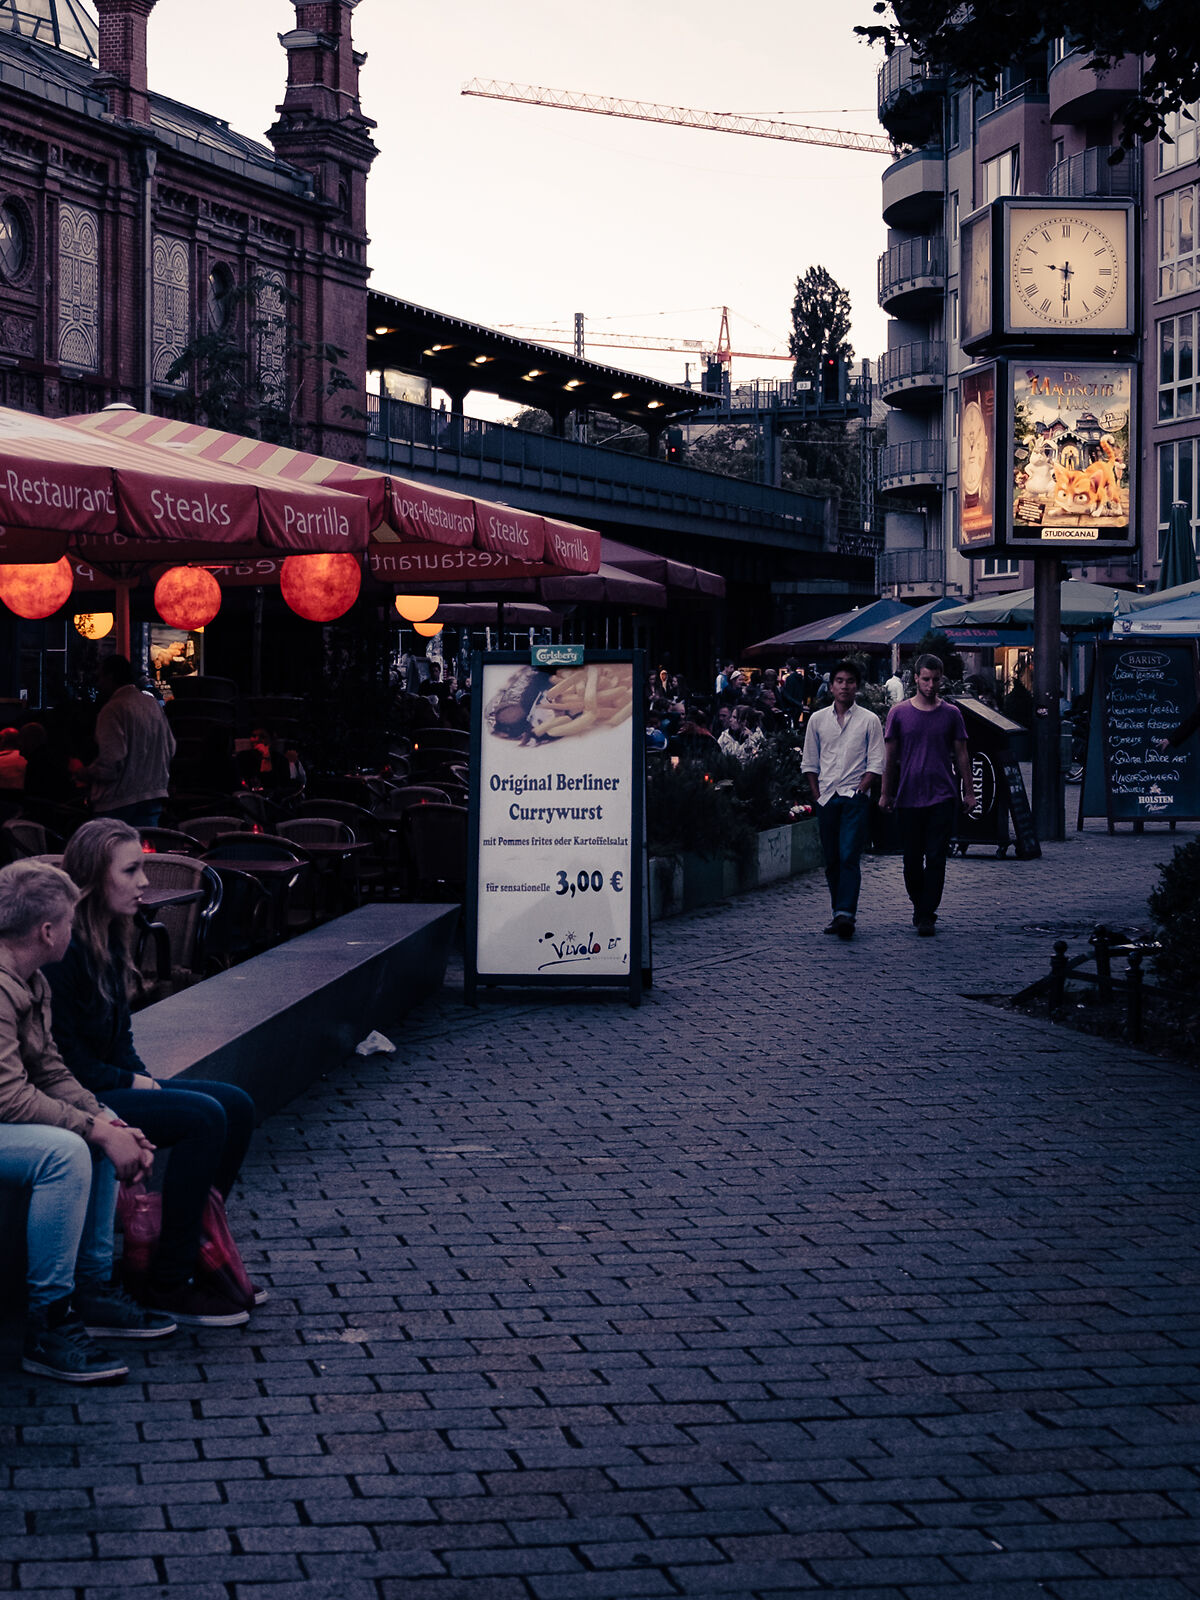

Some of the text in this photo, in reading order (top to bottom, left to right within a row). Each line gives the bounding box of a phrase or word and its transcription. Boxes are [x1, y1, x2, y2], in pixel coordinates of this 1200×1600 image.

[150, 489, 232, 527] Steaks
[391, 491, 475, 533] Tpas-Restaurant
[284, 504, 350, 538] Parrilla
[489, 515, 530, 546] Steaks
[1044, 530, 1096, 538] STUDIOCANAL
[554, 533, 589, 562] Parrilla
[536, 648, 578, 665] Carlsberg
[1128, 656, 1163, 665] BARIST
[490, 773, 620, 795] Original Berliner
[972, 757, 983, 815] BARIST
[1138, 796, 1174, 804] HOLSTEN
[509, 803, 603, 824] Currywurst
[483, 836, 628, 846] mit Pommes frites oder Kartoffelsalat
[486, 870, 624, 898] für sensationelle 3,00 €
